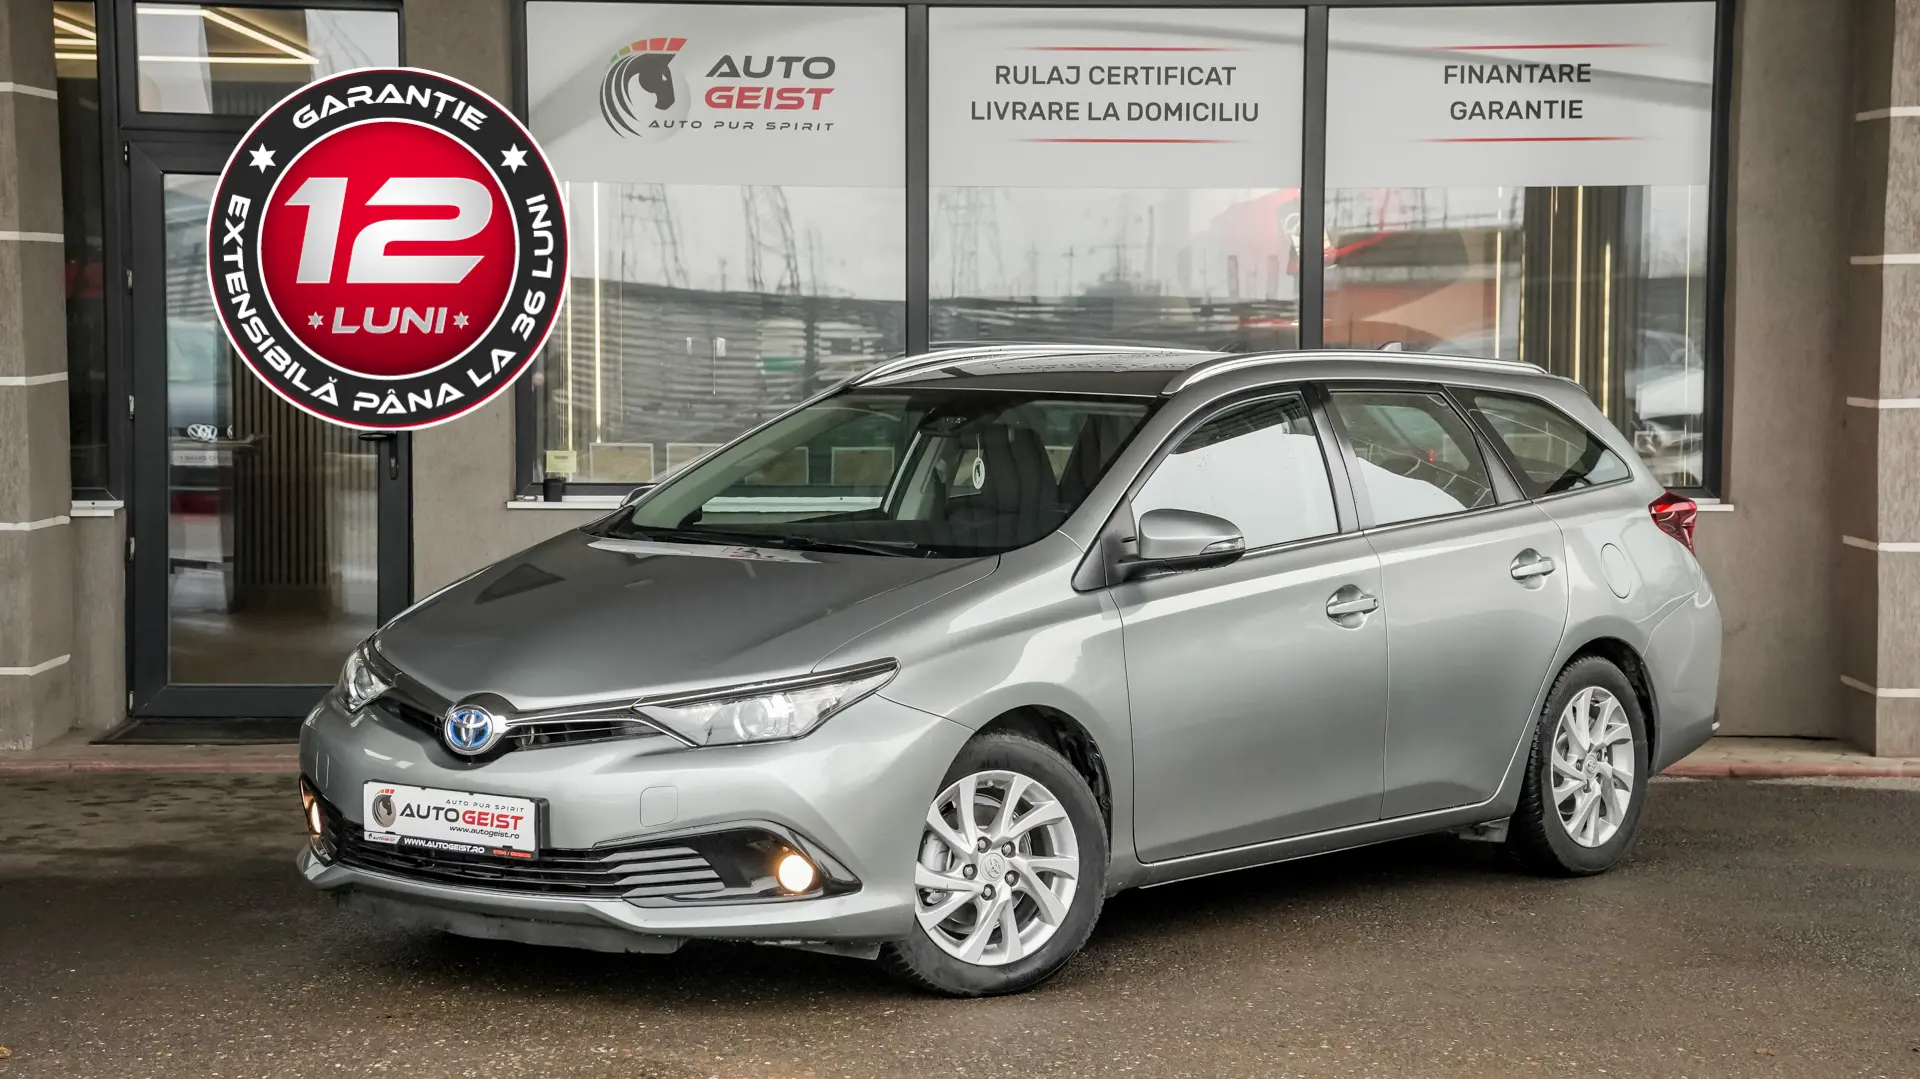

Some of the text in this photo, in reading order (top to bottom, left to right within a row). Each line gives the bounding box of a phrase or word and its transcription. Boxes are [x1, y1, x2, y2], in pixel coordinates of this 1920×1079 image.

[704, 54, 836, 79] AUTO
[995, 65, 1237, 86] RULAJ CERTIFICAT
[1444, 63, 1592, 84] FINANTARE
[704, 86, 835, 110] GEIST
[971, 101, 1260, 122] LIVRARE LA DOMICILIU
[1450, 100, 1583, 121] GARANTIE
[648, 119, 835, 132] AUTO PUR SPIRIT
[445, 799, 469, 807] AUTO
[495, 804, 525, 813] SPIRIT
[449, 825, 520, 839] www.autogeist.ro
[403, 837, 485, 854] WWW.AUTOGEIST.RO
